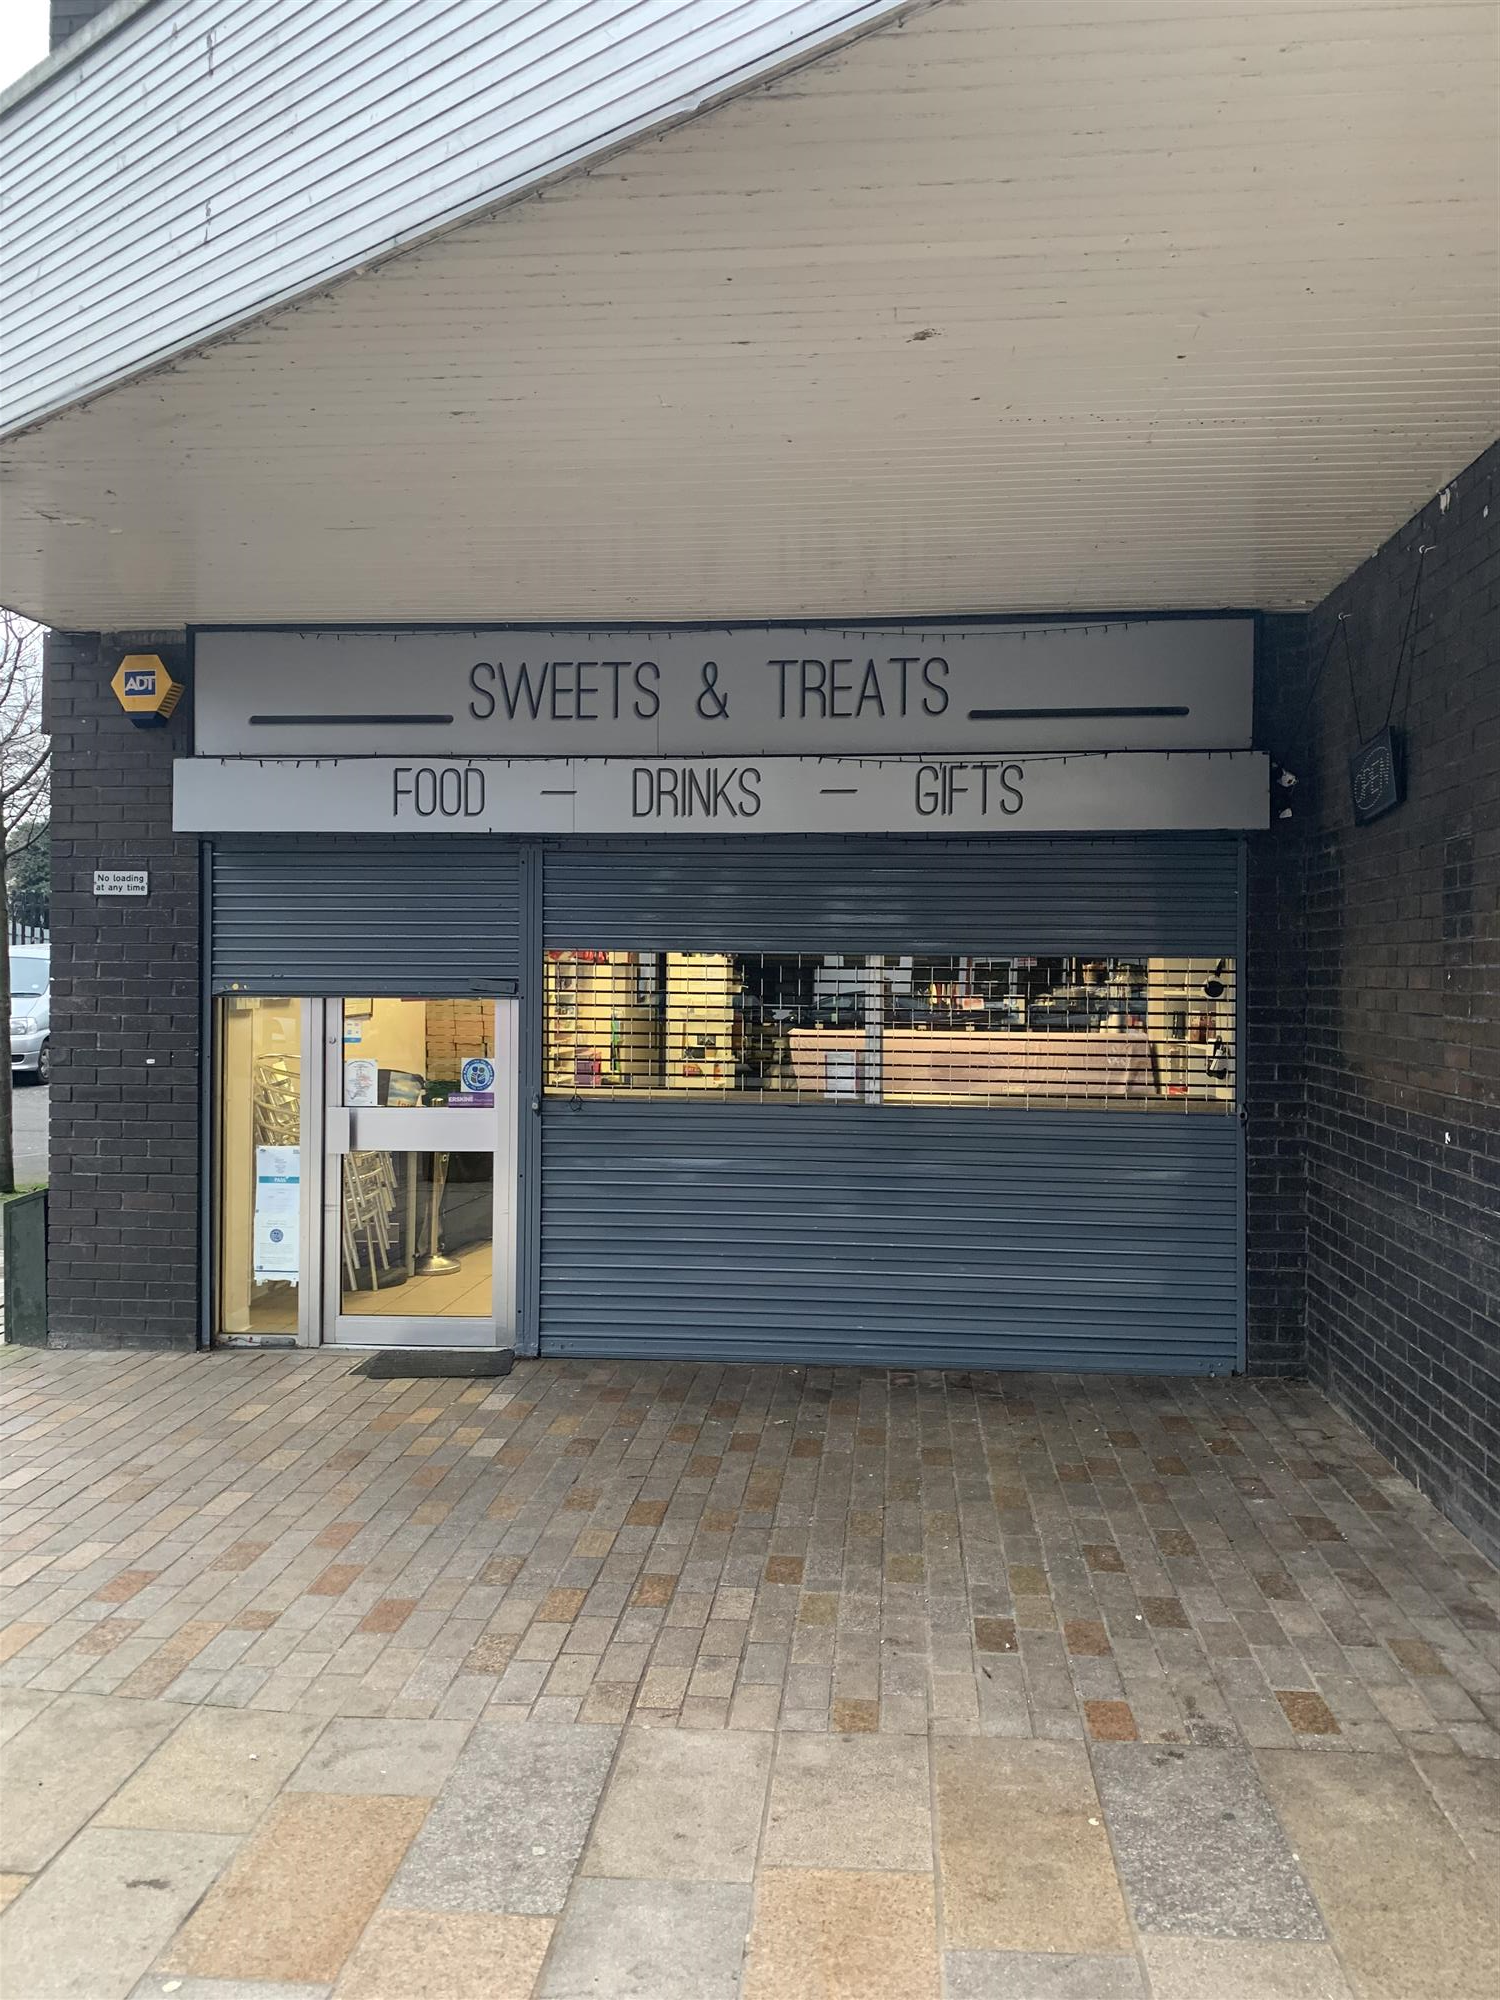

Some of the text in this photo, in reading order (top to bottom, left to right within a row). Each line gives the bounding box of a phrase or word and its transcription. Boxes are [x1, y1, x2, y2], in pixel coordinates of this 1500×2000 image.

[125, 676, 156, 691] ADT
[468, 656, 951, 720] SWEETS & TREATS
[392, 764, 1025, 818] FOOD DRINKS GIFTS
[97, 874, 144, 883] No loading
[108, 884, 123, 893] any
[127, 883, 146, 891] time
